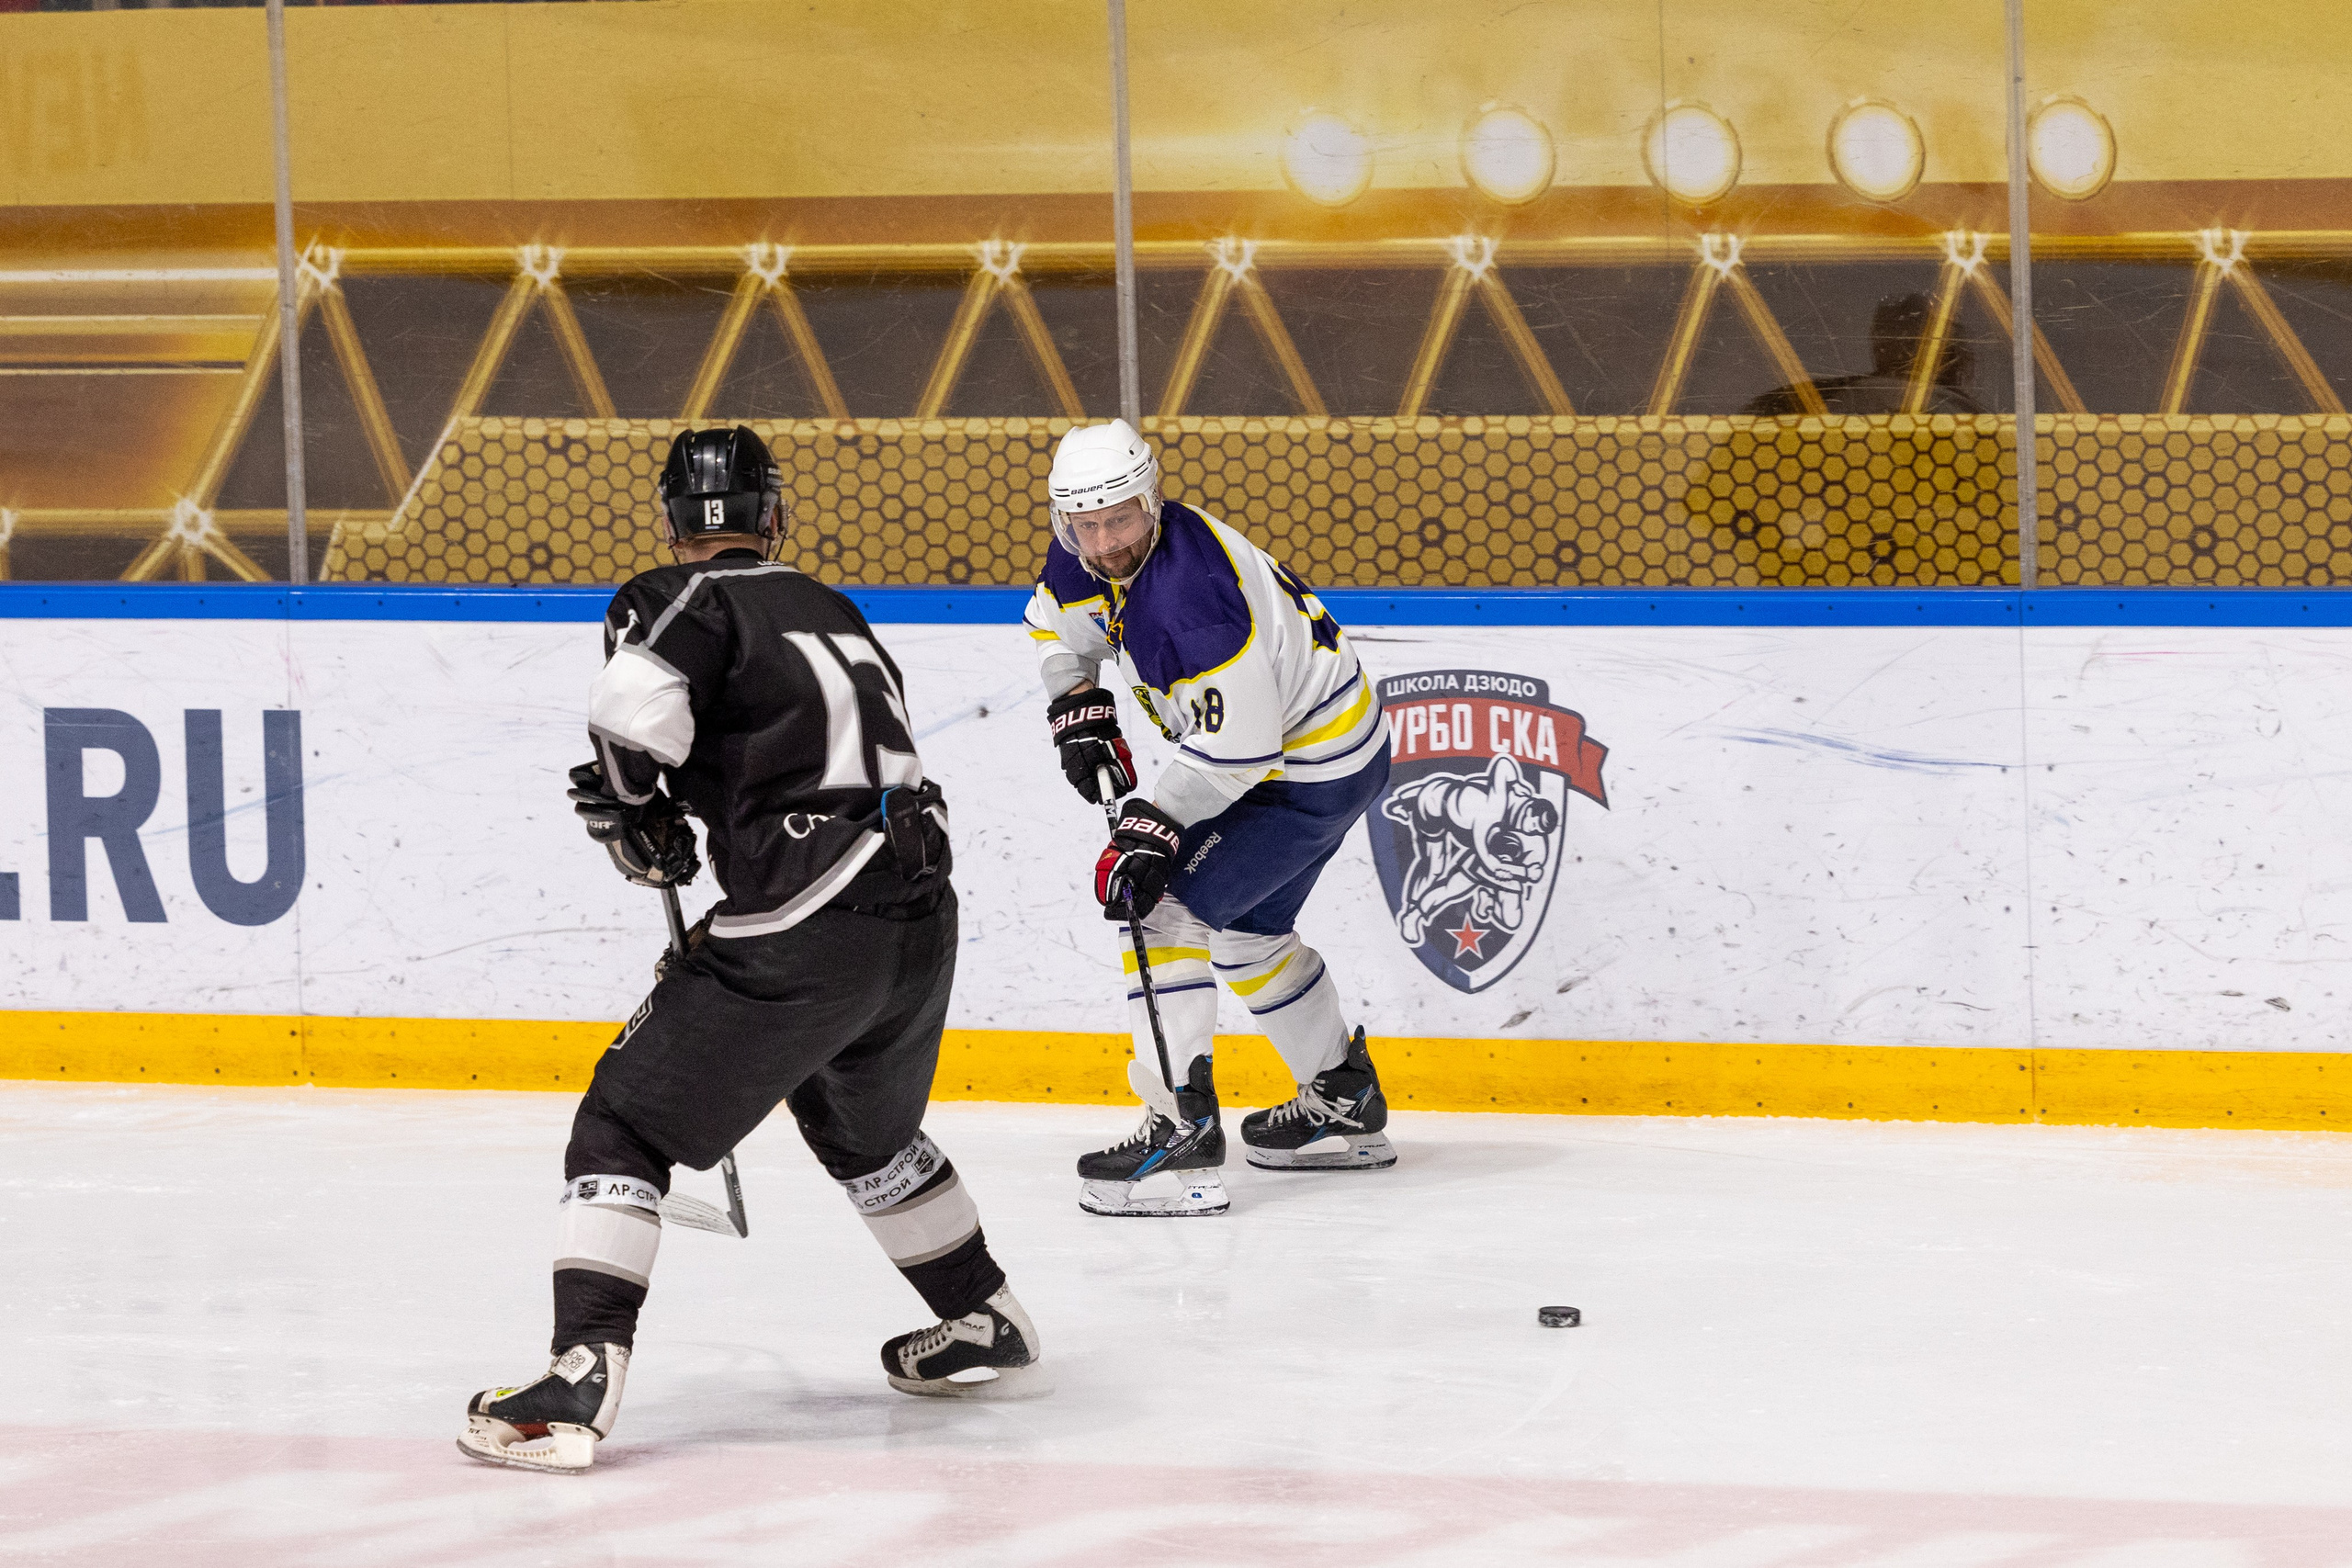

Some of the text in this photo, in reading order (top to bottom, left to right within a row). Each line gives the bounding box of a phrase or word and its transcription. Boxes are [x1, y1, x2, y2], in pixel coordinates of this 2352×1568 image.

[1071, 484, 1103, 495] BAUER
[704, 500, 725, 525] 13
[1386, 674, 1537, 698] ШКОЛА ДЗЮДО
[1385, 704, 1559, 766] УРБО СКА
[1117, 817, 1180, 855] BAUE
[1183, 831, 1223, 875] Reebok
